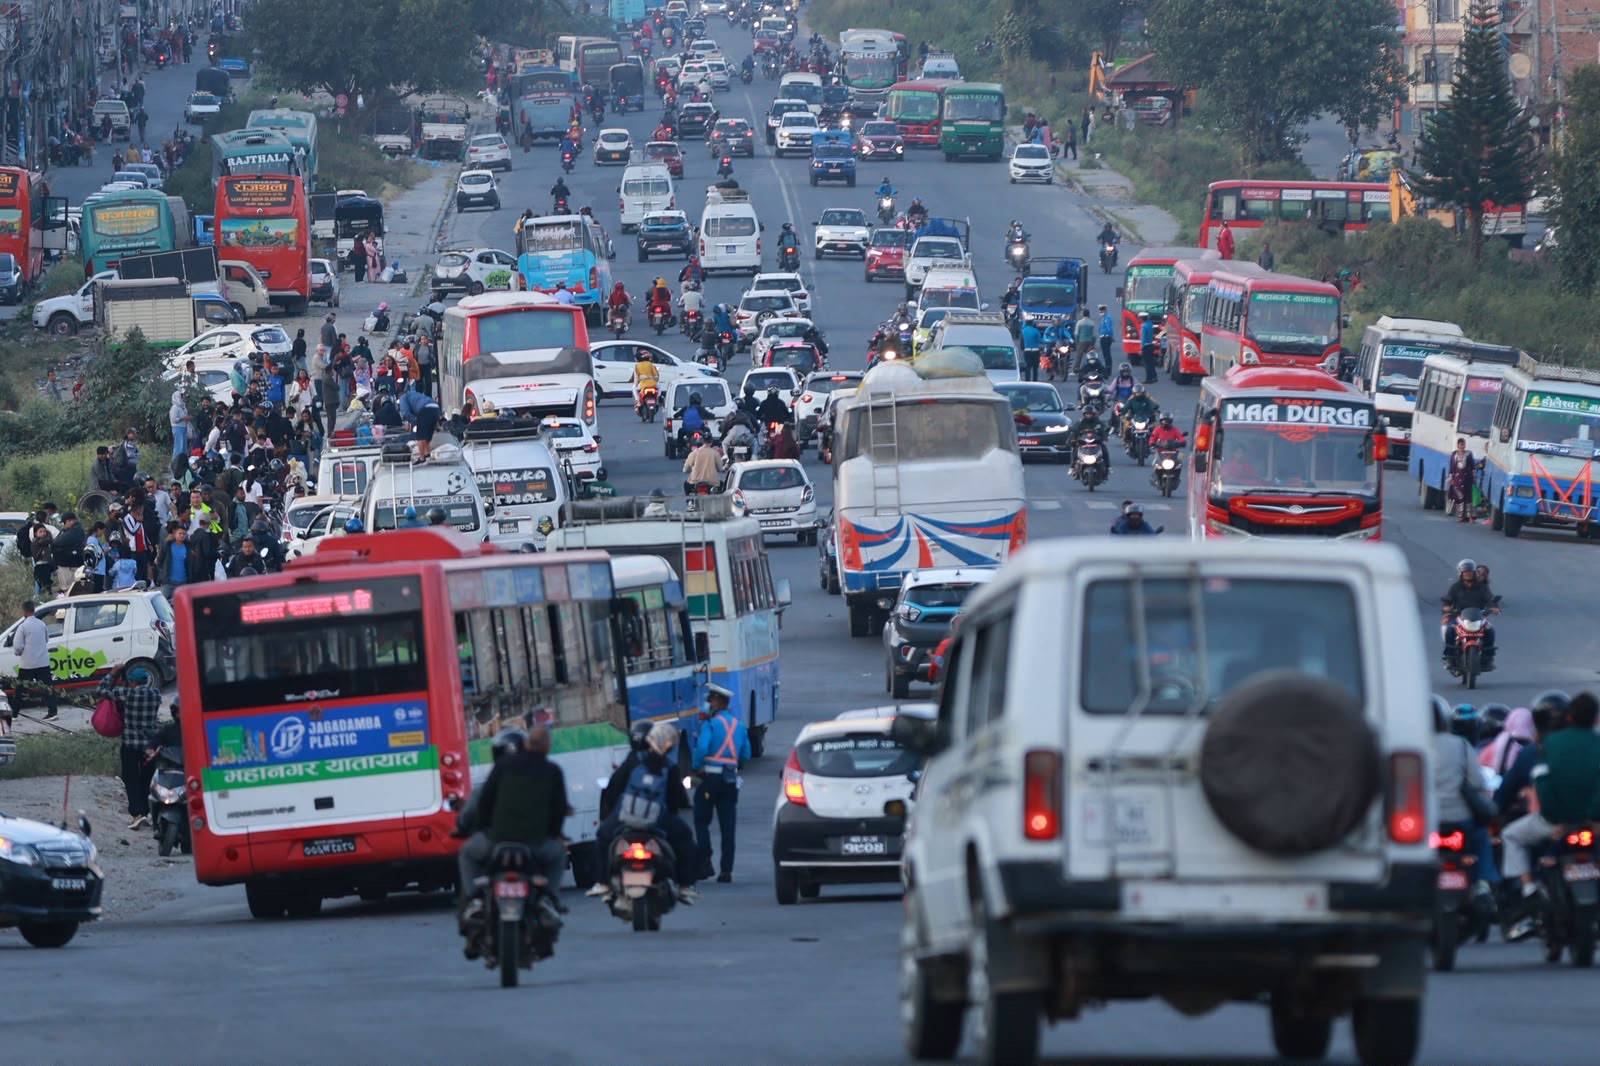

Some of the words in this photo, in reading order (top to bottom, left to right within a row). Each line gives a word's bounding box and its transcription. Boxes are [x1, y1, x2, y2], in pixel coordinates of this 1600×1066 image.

[948, 94, 971, 103] SAJHA
[228, 154, 290, 167] RAJTHALA
[1226, 403, 1278, 422] MAA
[1286, 405, 1369, 426] DURGA
[474, 470, 547, 484] AHALKA
[48, 655, 96, 672] Drive
[308, 716, 382, 735] JAGADAMBA
[308, 732, 358, 749] PLASTIC
[224, 760, 321, 785] महानगर
[324, 750, 420, 774] यातायात
